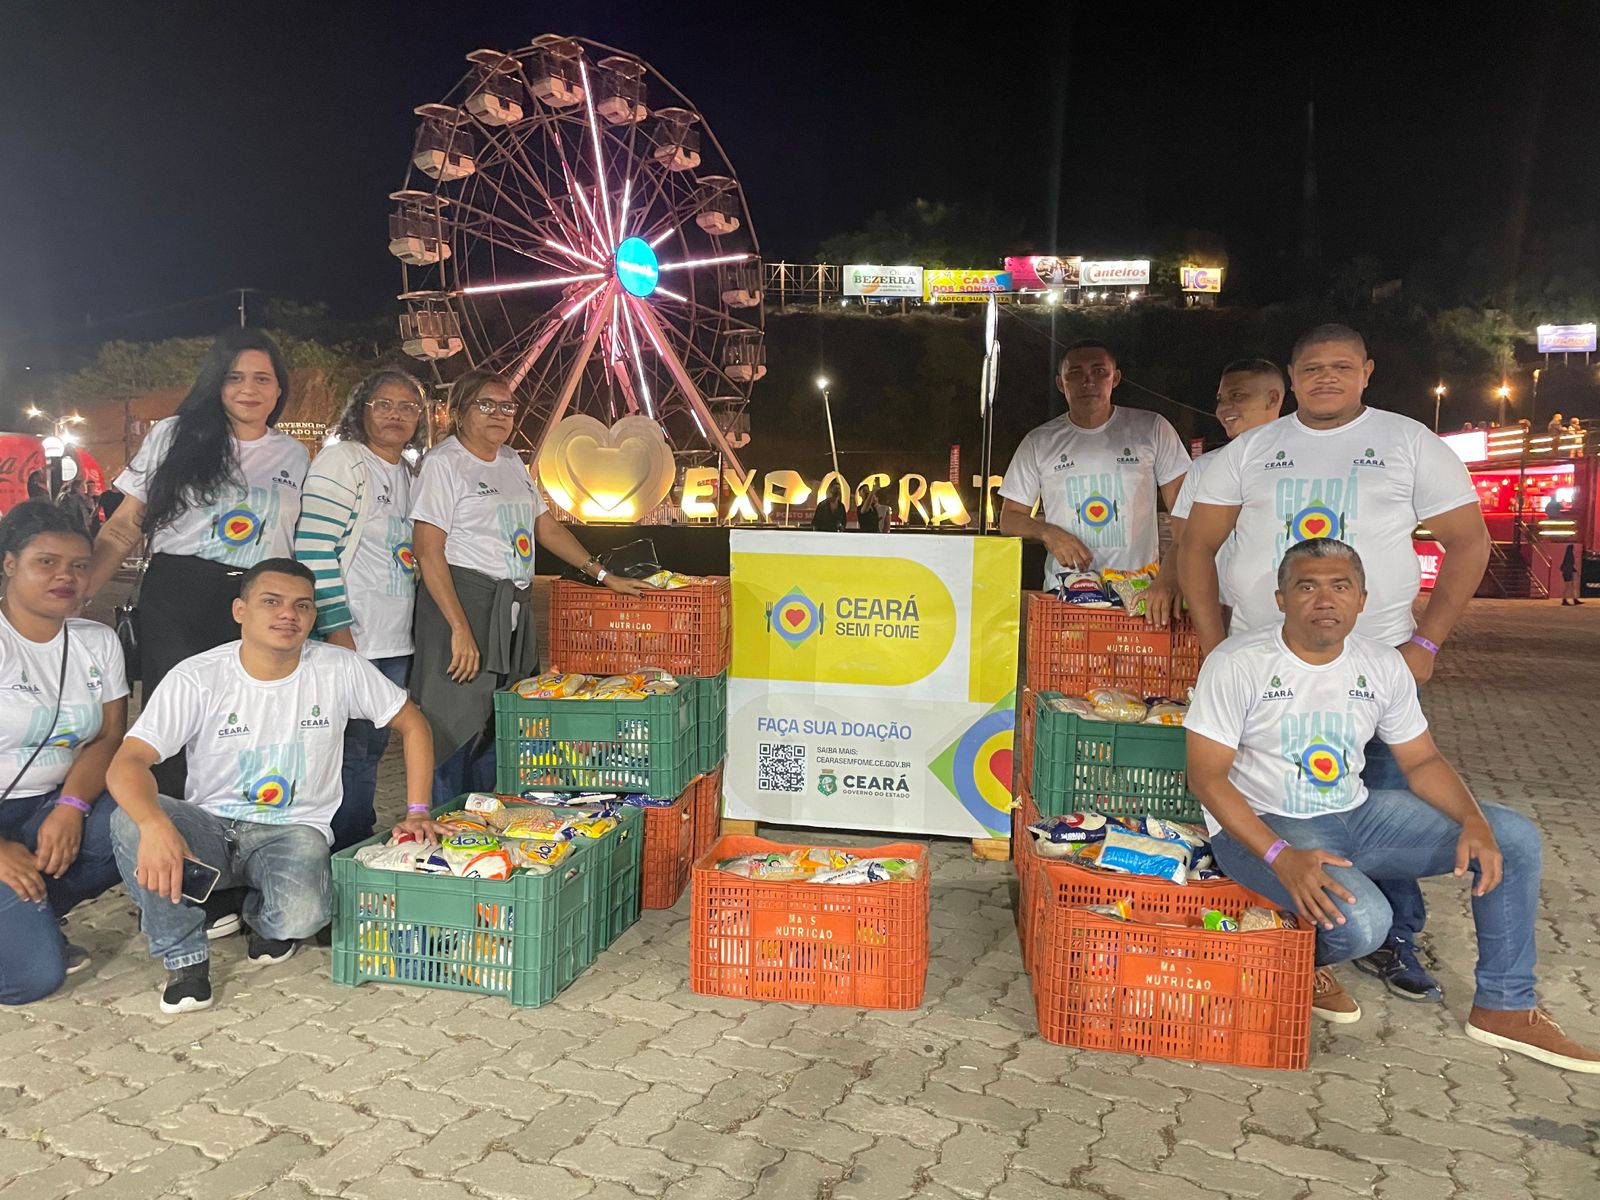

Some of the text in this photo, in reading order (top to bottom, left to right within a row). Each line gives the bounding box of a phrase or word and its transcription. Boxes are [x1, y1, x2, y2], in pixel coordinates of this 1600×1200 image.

[854, 276, 916, 284] BEZERRA
[1265, 460, 1294, 468] CEARÁ
[1353, 458, 1385, 467] CEARÁ
[836, 594, 920, 621] CEARÁ
[609, 621, 652, 631] NUTRICAO
[835, 622, 920, 639] SEM FOME
[1106, 644, 1154, 654] NUTRICAO
[1263, 688, 1294, 699] CEARÁ
[301, 717, 330, 727] CEARÁ
[218, 724, 250, 736] CEARÁ
[758, 717, 912, 742] FAÇA SUA DOAÇÃO
[816, 746, 859, 756] SAIBA MAIS:
[816, 757, 911, 768] CEARASEMFOME.CE.GOV.BR
[843, 774, 910, 792] CEARÁ
[843, 789, 873, 797] GOVERNO
[885, 791, 910, 799] ESTADO
[775, 926, 833, 940] NUTRICAO
[1145, 974, 1212, 991] NUTRICAO
